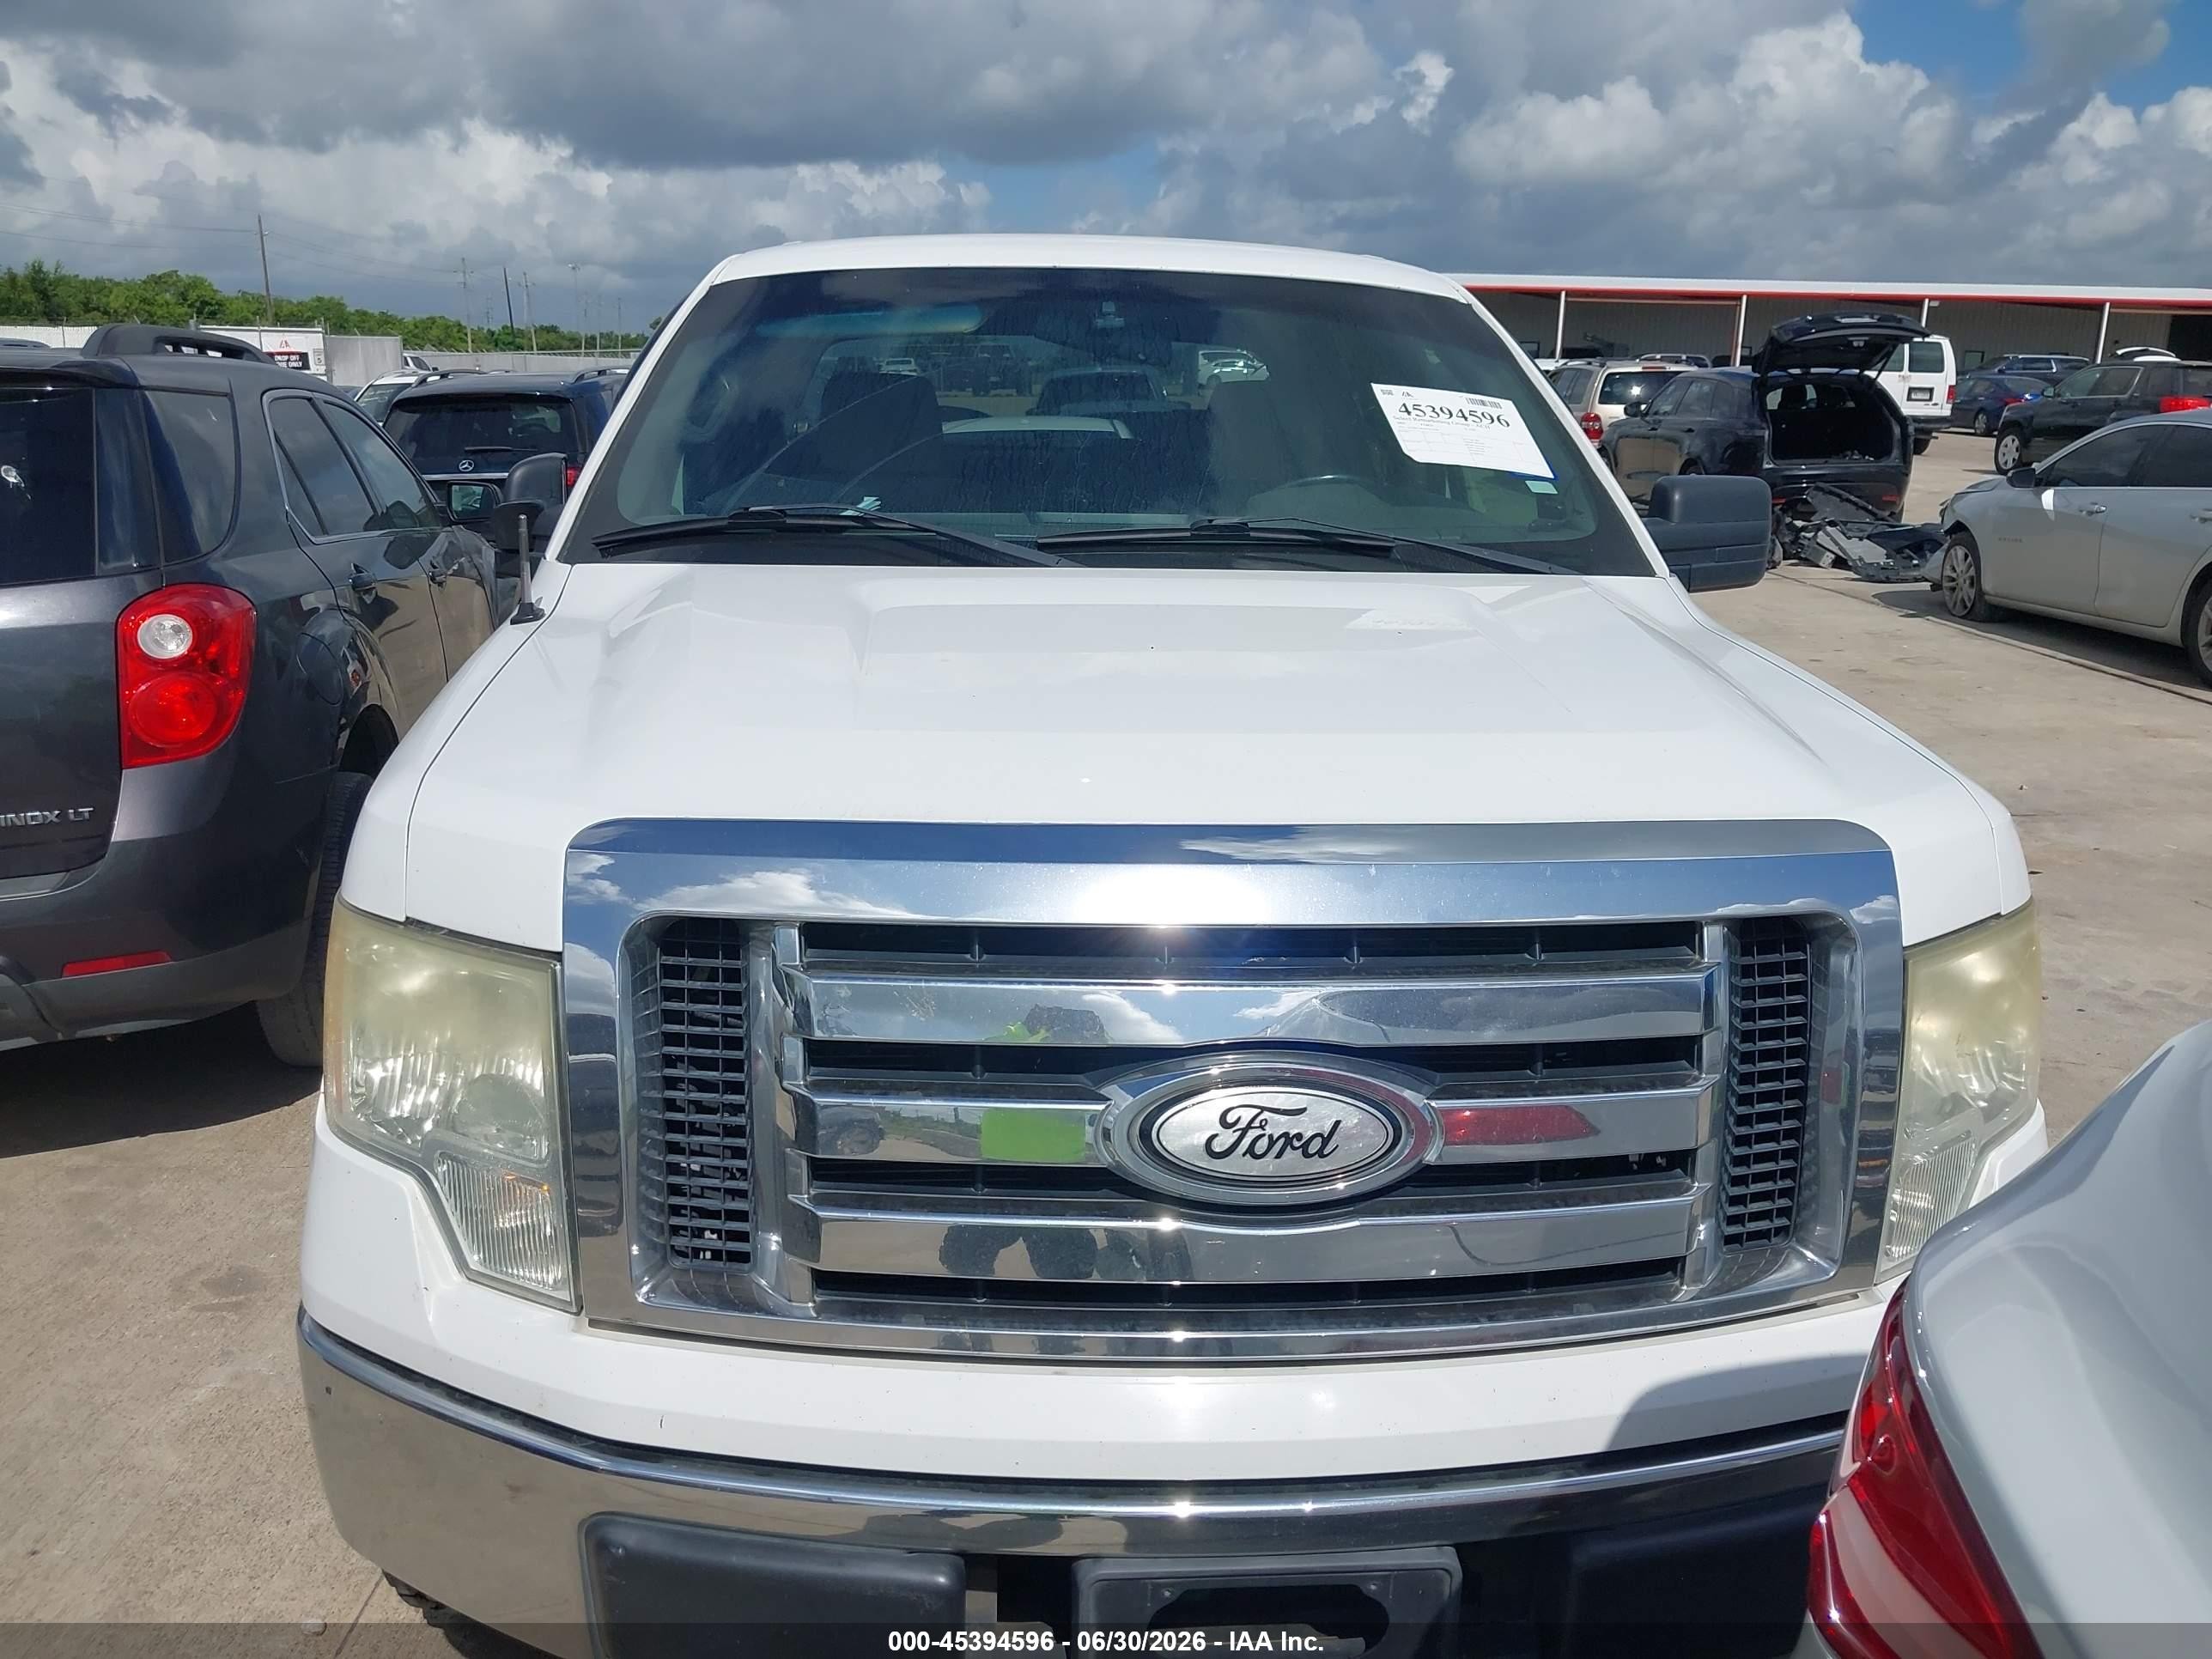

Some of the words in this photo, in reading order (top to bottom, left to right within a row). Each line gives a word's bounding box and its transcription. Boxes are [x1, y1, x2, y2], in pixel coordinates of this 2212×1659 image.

[1398, 402, 1510, 428] 45394596
[68, 807, 94, 822] LT
[1205, 1103, 1342, 1160] Ford
